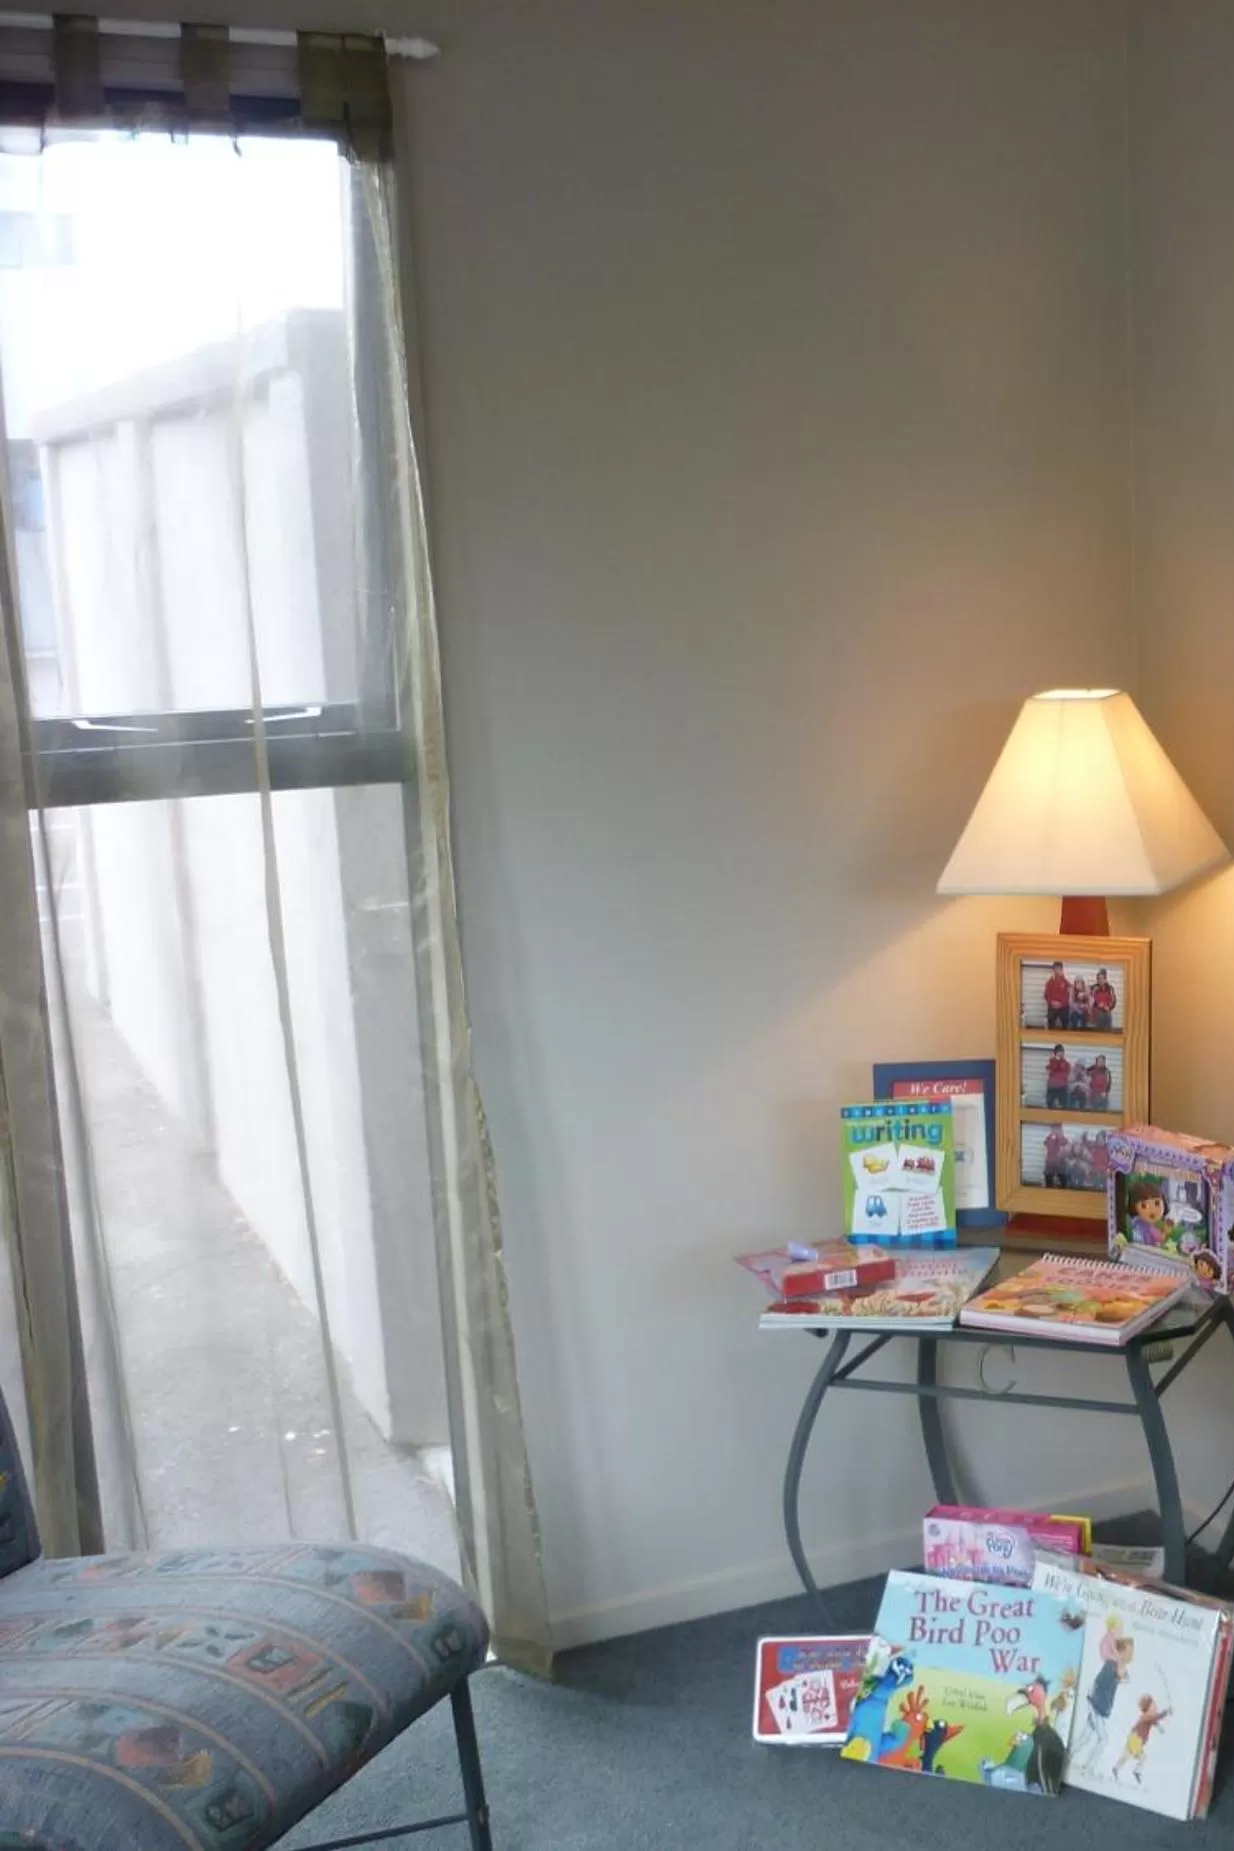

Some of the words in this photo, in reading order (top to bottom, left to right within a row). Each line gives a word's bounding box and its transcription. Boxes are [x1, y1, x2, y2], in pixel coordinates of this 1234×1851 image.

[852, 1119, 944, 1146] writing
[915, 1589, 962, 1614] The
[967, 1591, 1036, 1618] Great
[1140, 1599, 1169, 1621] Bear
[909, 1616, 965, 1645] Bird
[975, 1622, 1022, 1647] Poo
[989, 1648, 1041, 1675] War
